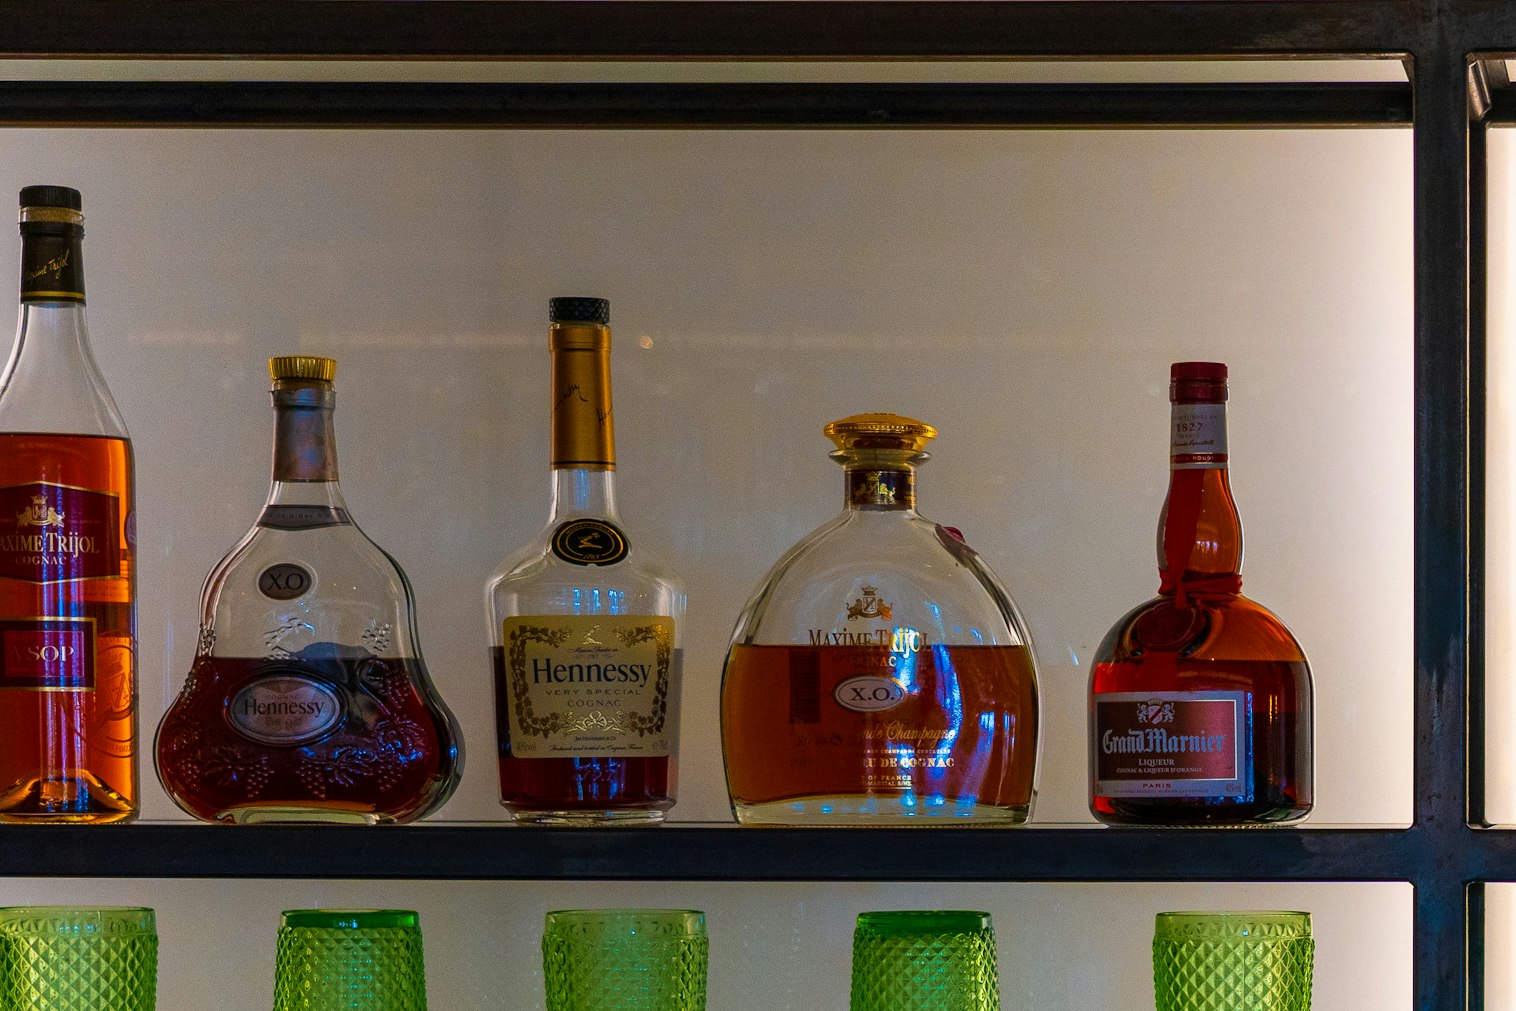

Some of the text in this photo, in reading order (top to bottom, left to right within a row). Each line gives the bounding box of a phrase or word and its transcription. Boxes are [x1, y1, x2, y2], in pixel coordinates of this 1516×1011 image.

[1177, 423, 1202, 432] 1827
[533, 658, 652, 687] Hennessy
[244, 700, 325, 717] Hennessy
[1103, 728, 1225, 754] Grand Marnier
